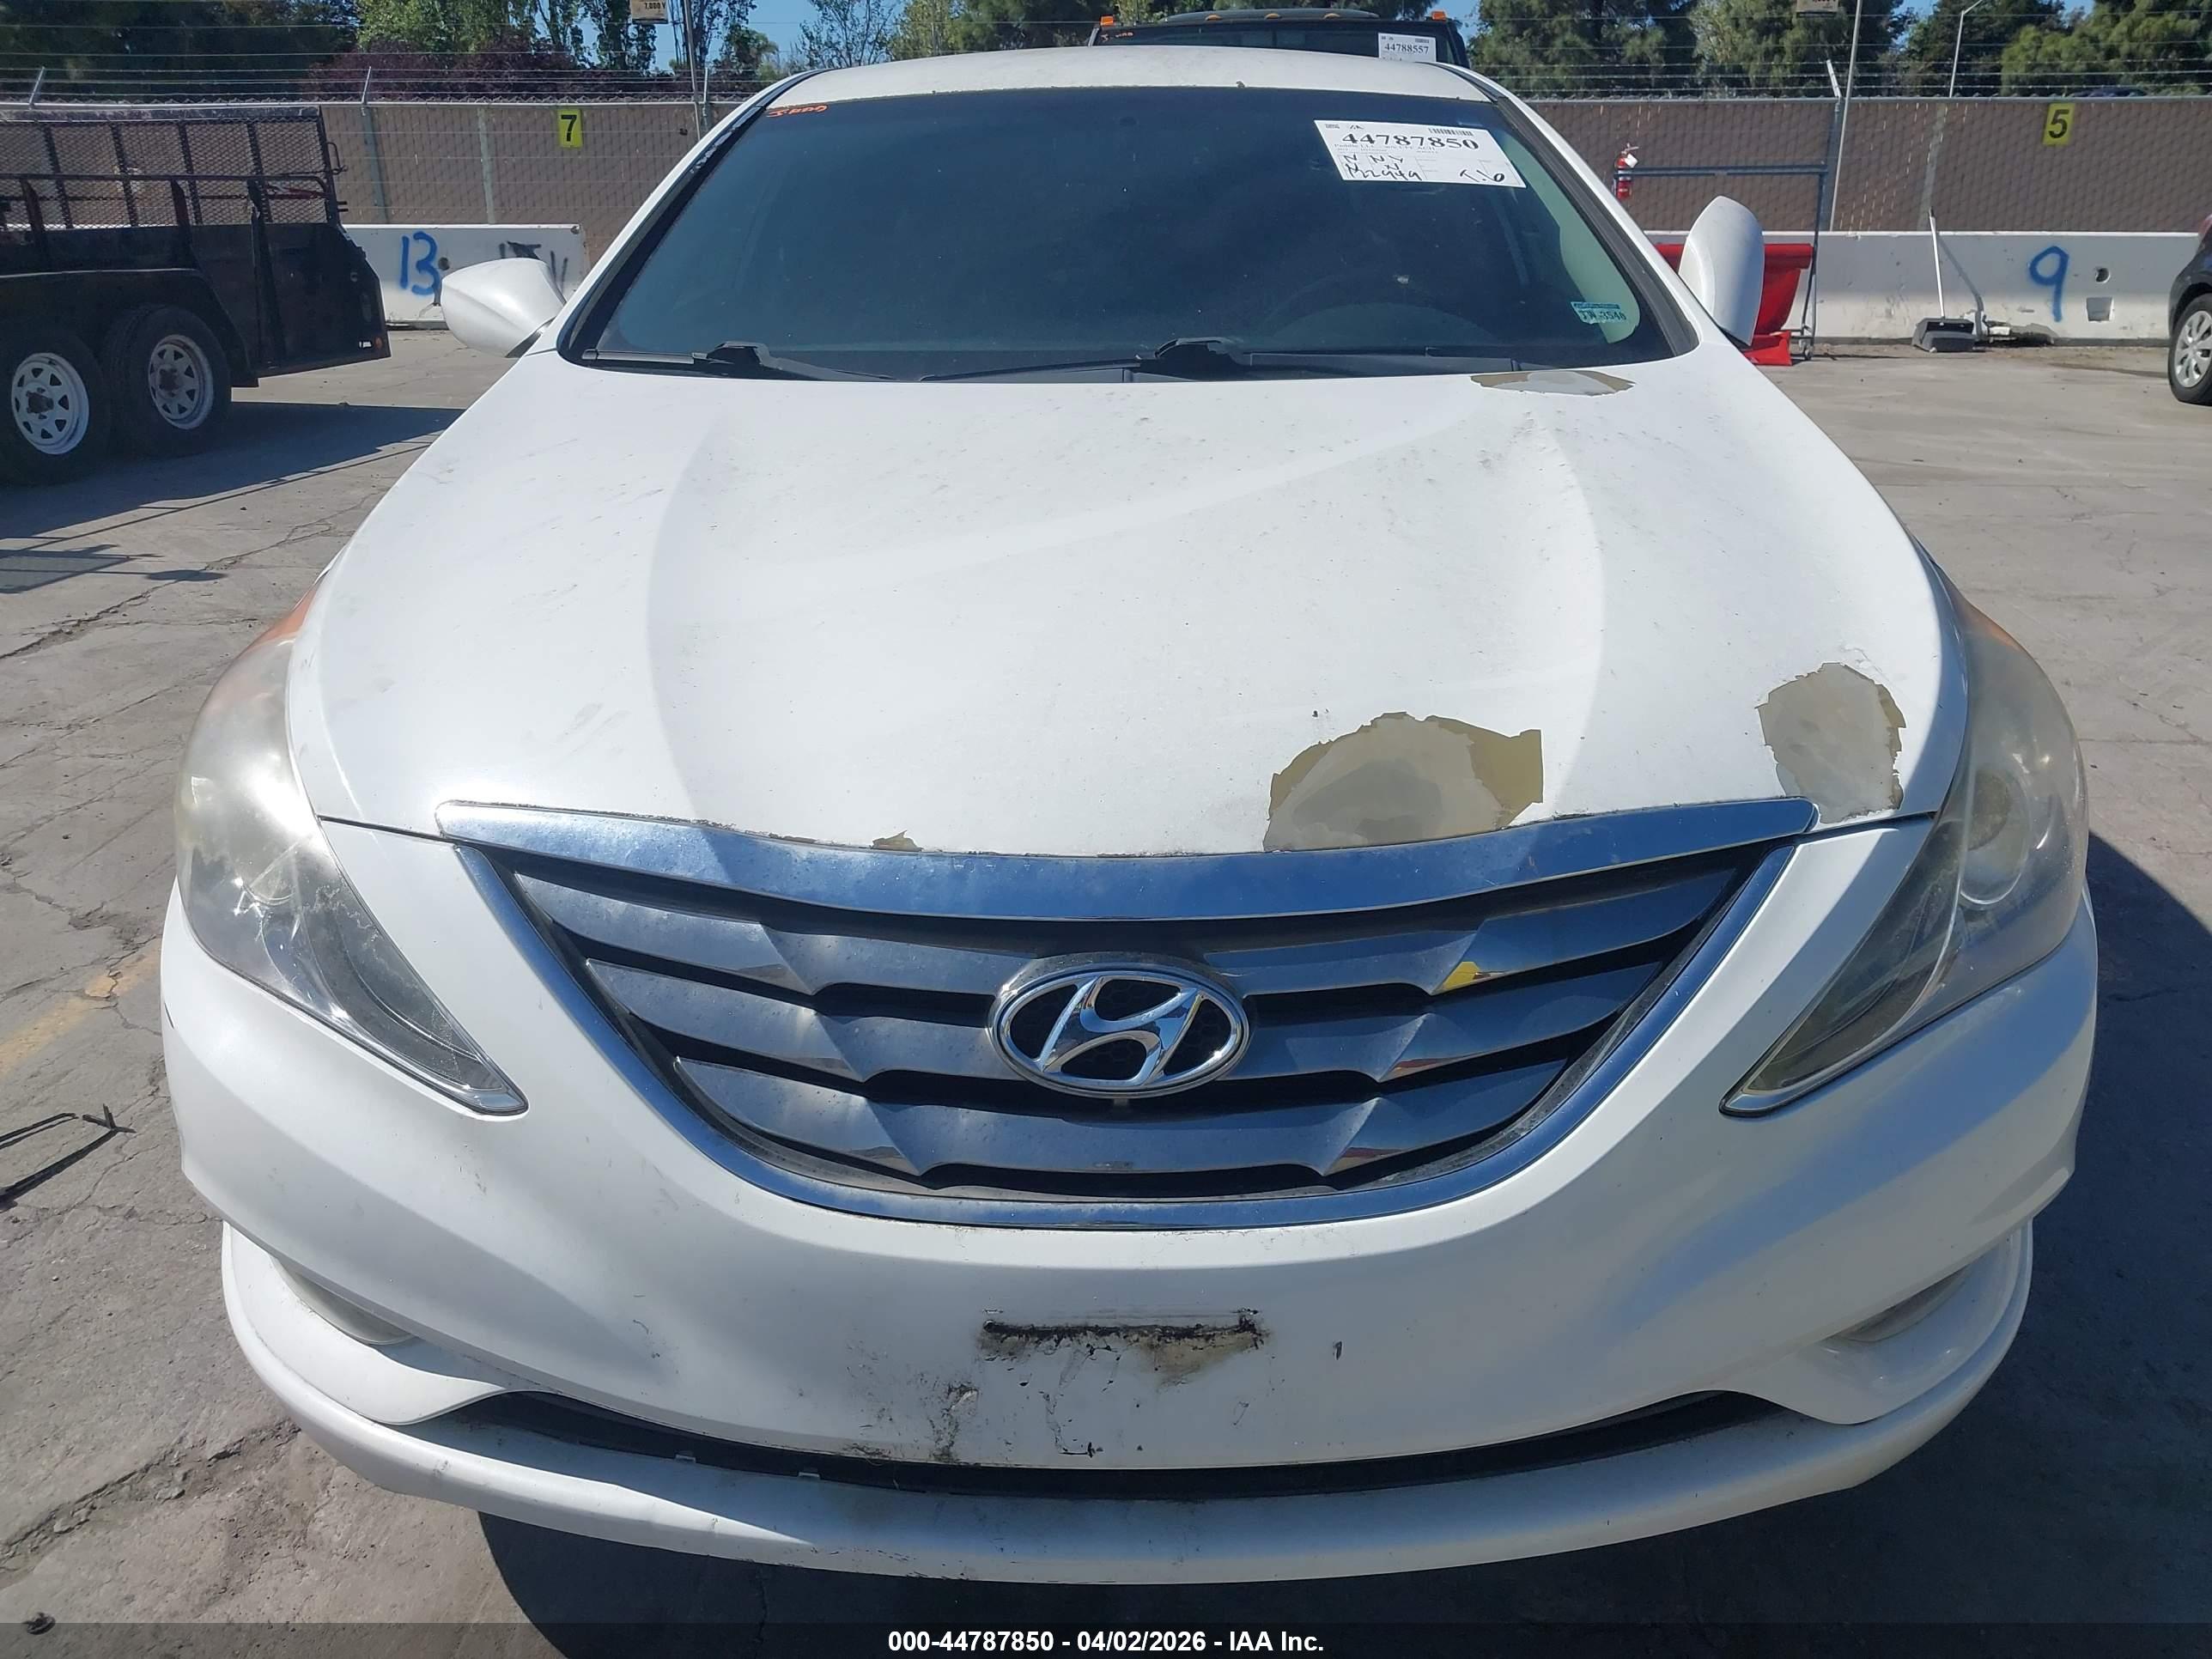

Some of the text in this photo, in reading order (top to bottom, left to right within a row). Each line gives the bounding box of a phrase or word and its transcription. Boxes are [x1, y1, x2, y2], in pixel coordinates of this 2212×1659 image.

[1384, 43, 1429, 54] 44788557
[561, 114, 577, 142] 7
[2048, 109, 2069, 138] 5
[1342, 133, 1479, 150] 44787850
[399, 231, 440, 296] 13
[2029, 246, 2069, 322] 9
